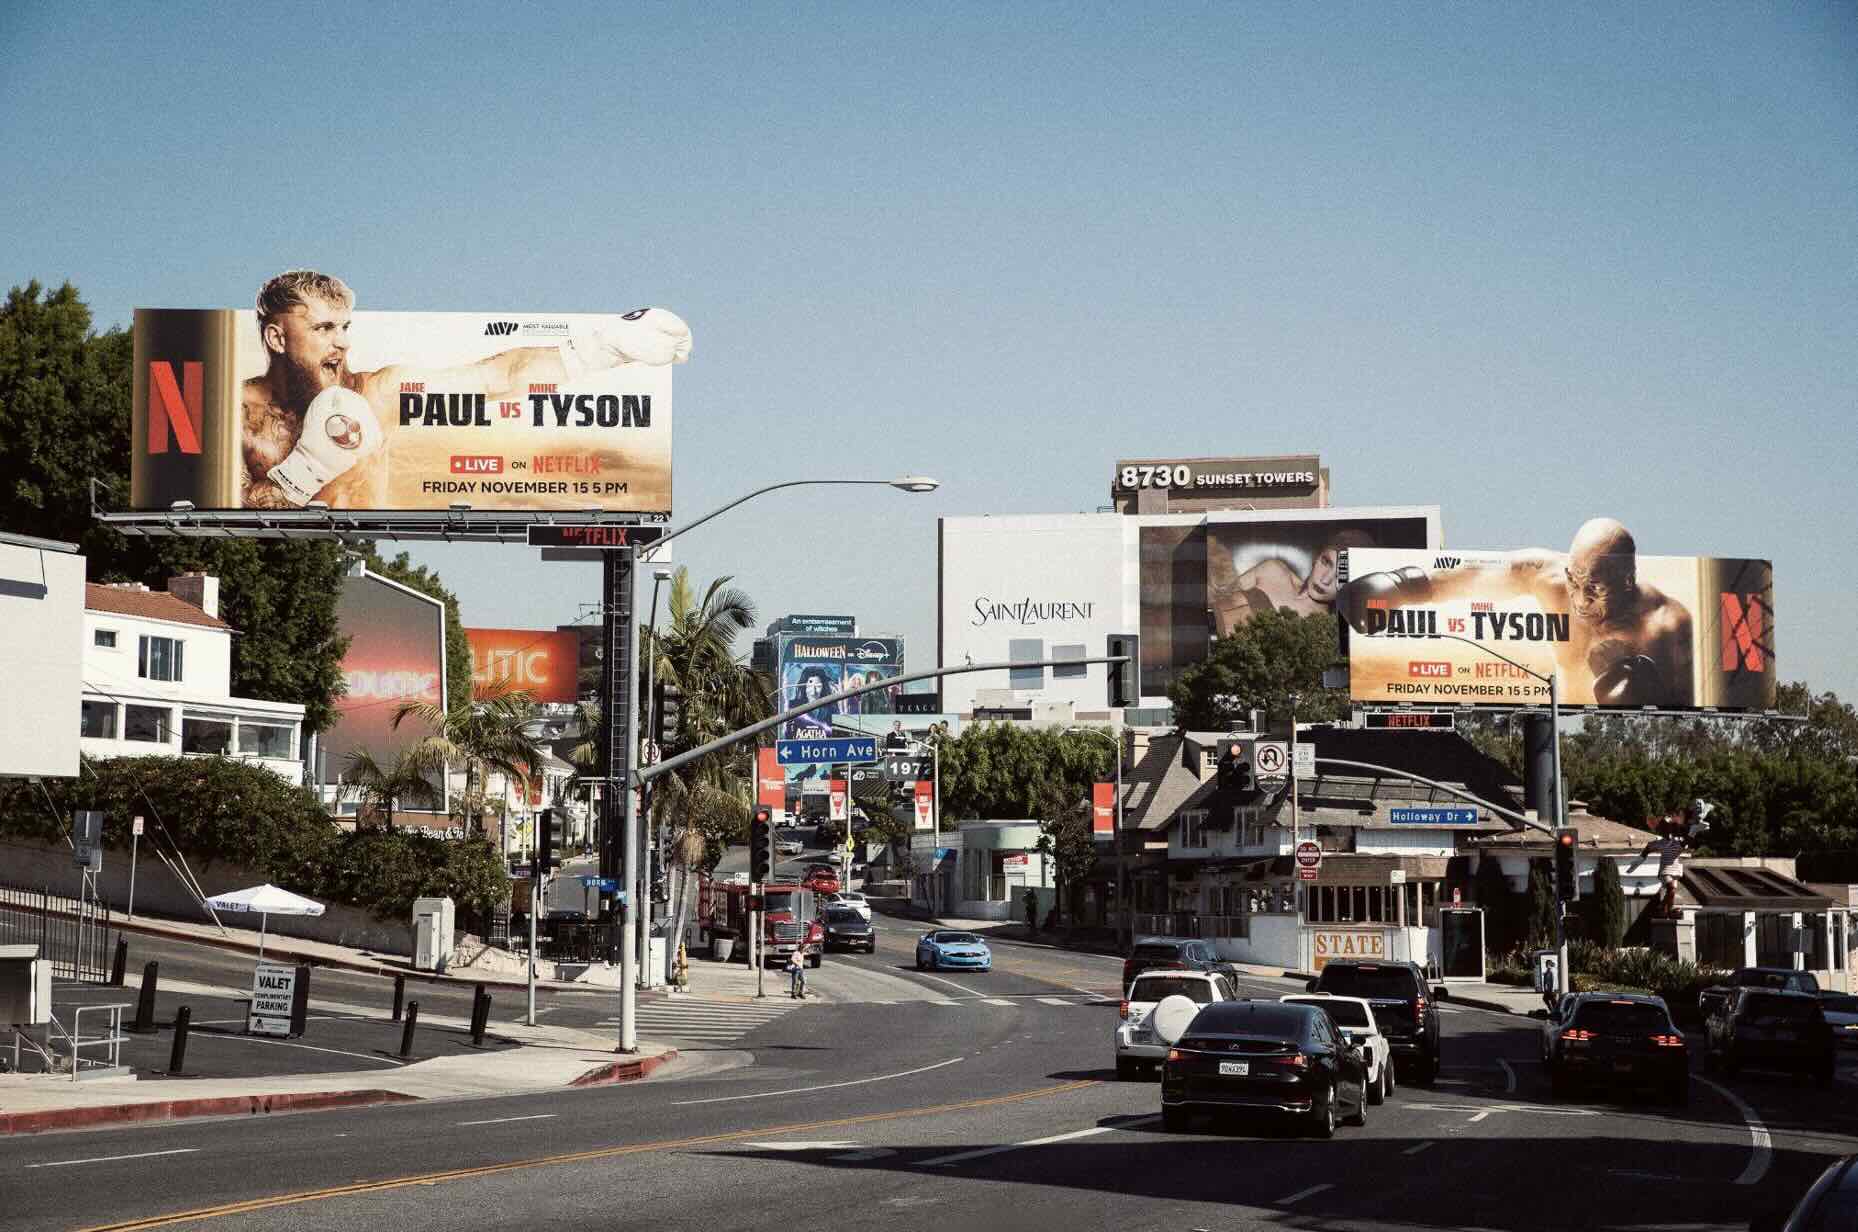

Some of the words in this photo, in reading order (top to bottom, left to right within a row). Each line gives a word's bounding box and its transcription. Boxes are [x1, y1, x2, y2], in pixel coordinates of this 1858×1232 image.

[400, 382, 425, 393] JAKE
[528, 383, 558, 393] MIKE
[399, 393, 491, 427] PAUL
[500, 401, 521, 418] VS
[528, 394, 651, 428] TYSON
[465, 460, 498, 471] LIVE
[511, 460, 526, 470] ON
[533, 455, 602, 474] NETFLIX
[1121, 465, 1190, 487] 8730
[1197, 473, 1251, 485] SUNSET
[1255, 471, 1314, 484] TOWERS
[423, 481, 477, 493] FRIDAY
[481, 481, 567, 494] NOVEMBER
[573, 482, 589, 494] 15
[592, 482, 602, 494] 5
[605, 482, 628, 494] PM
[1367, 608, 1441, 638] PAUL
[1448, 618, 1465, 632] VS
[1471, 612, 1570, 641] TYSON
[794, 643, 847, 659] HALLOWEEN
[1420, 664, 1448, 675] LIVE
[1476, 662, 1530, 679] NETFLIX
[1387, 683, 1430, 695] FRIDAY
[1434, 683, 1503, 696] NOVEMBER
[1508, 685, 1520, 696] 15
[1523, 685, 1531, 696] 5
[1534, 685, 1552, 697] PM
[1388, 715, 1430, 727] NETFLIX
[796, 728, 827, 739] AGATHA
[801, 745, 837, 758] Horn
[846, 744, 873, 757] Ave
[1392, 812, 1440, 822] Holloway
[1447, 812, 1460, 821] Dr
[216, 901, 238, 911] VALET
[1317, 934, 1382, 954] STATE
[259, 976, 291, 990] VALET
[256, 1001, 288, 1011] PARKING
